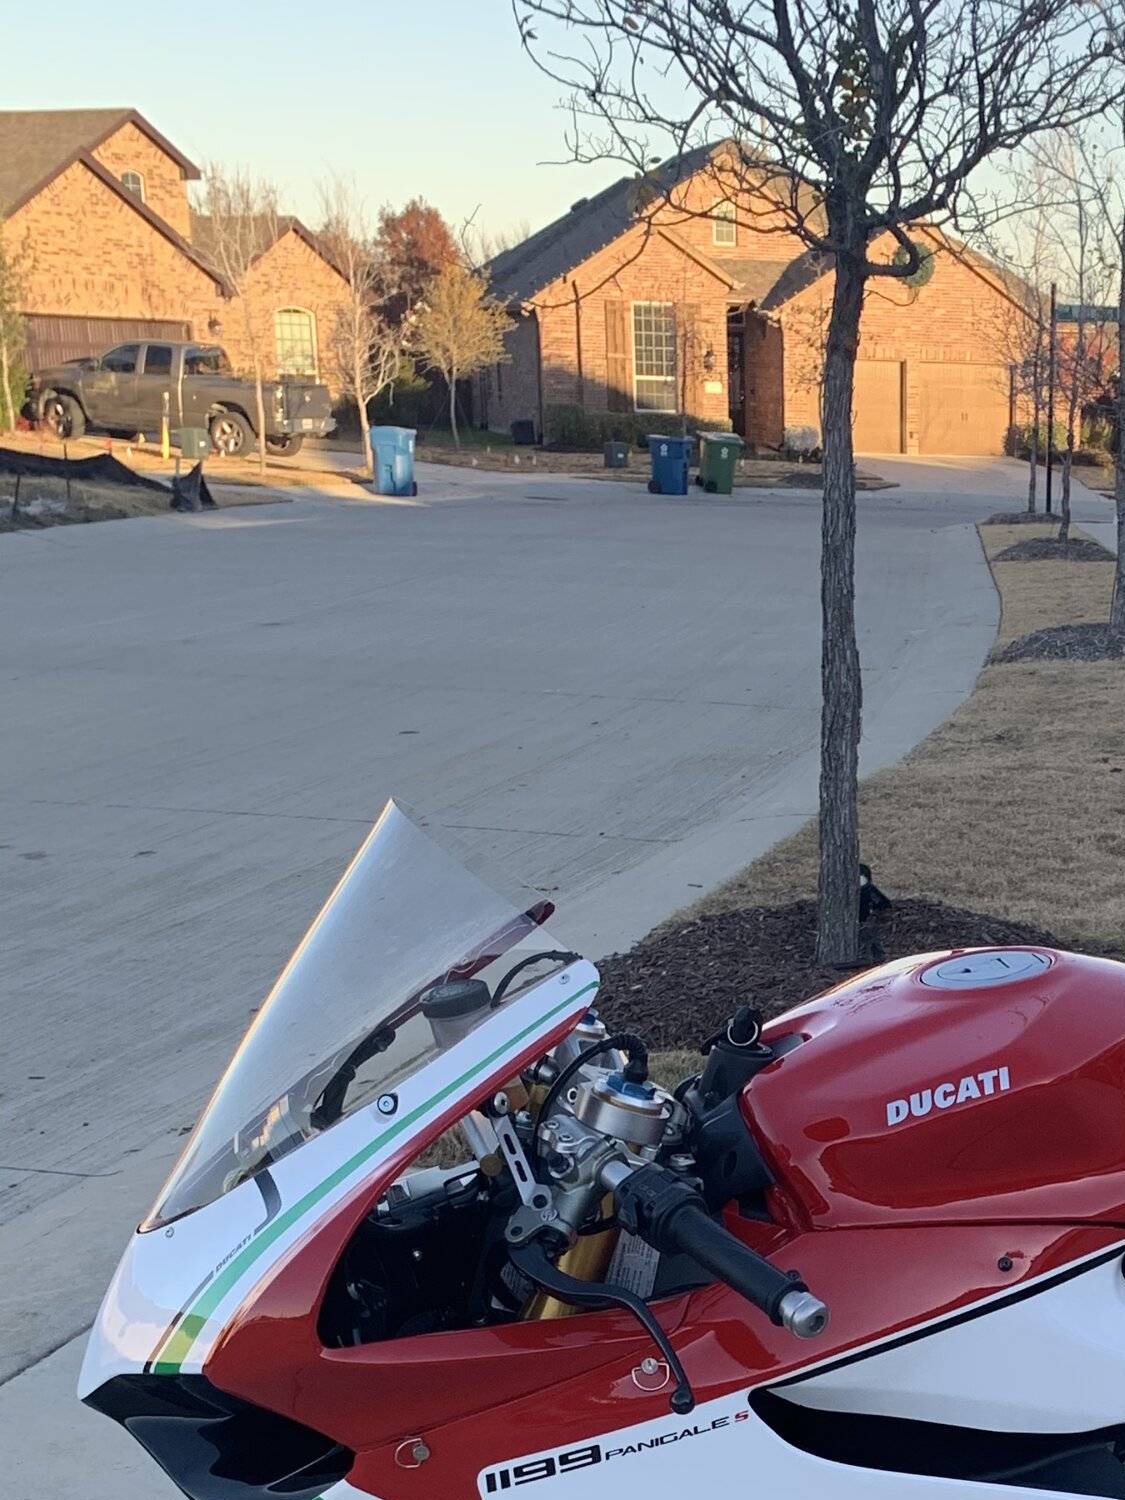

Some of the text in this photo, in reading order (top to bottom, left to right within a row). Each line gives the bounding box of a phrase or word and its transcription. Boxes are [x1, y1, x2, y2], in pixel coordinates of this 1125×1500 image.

[886, 1066, 1010, 1127] DUCATI
[215, 1233, 252, 1273] DUCATI
[485, 1410, 750, 1493] 1199 PANIGALE S
